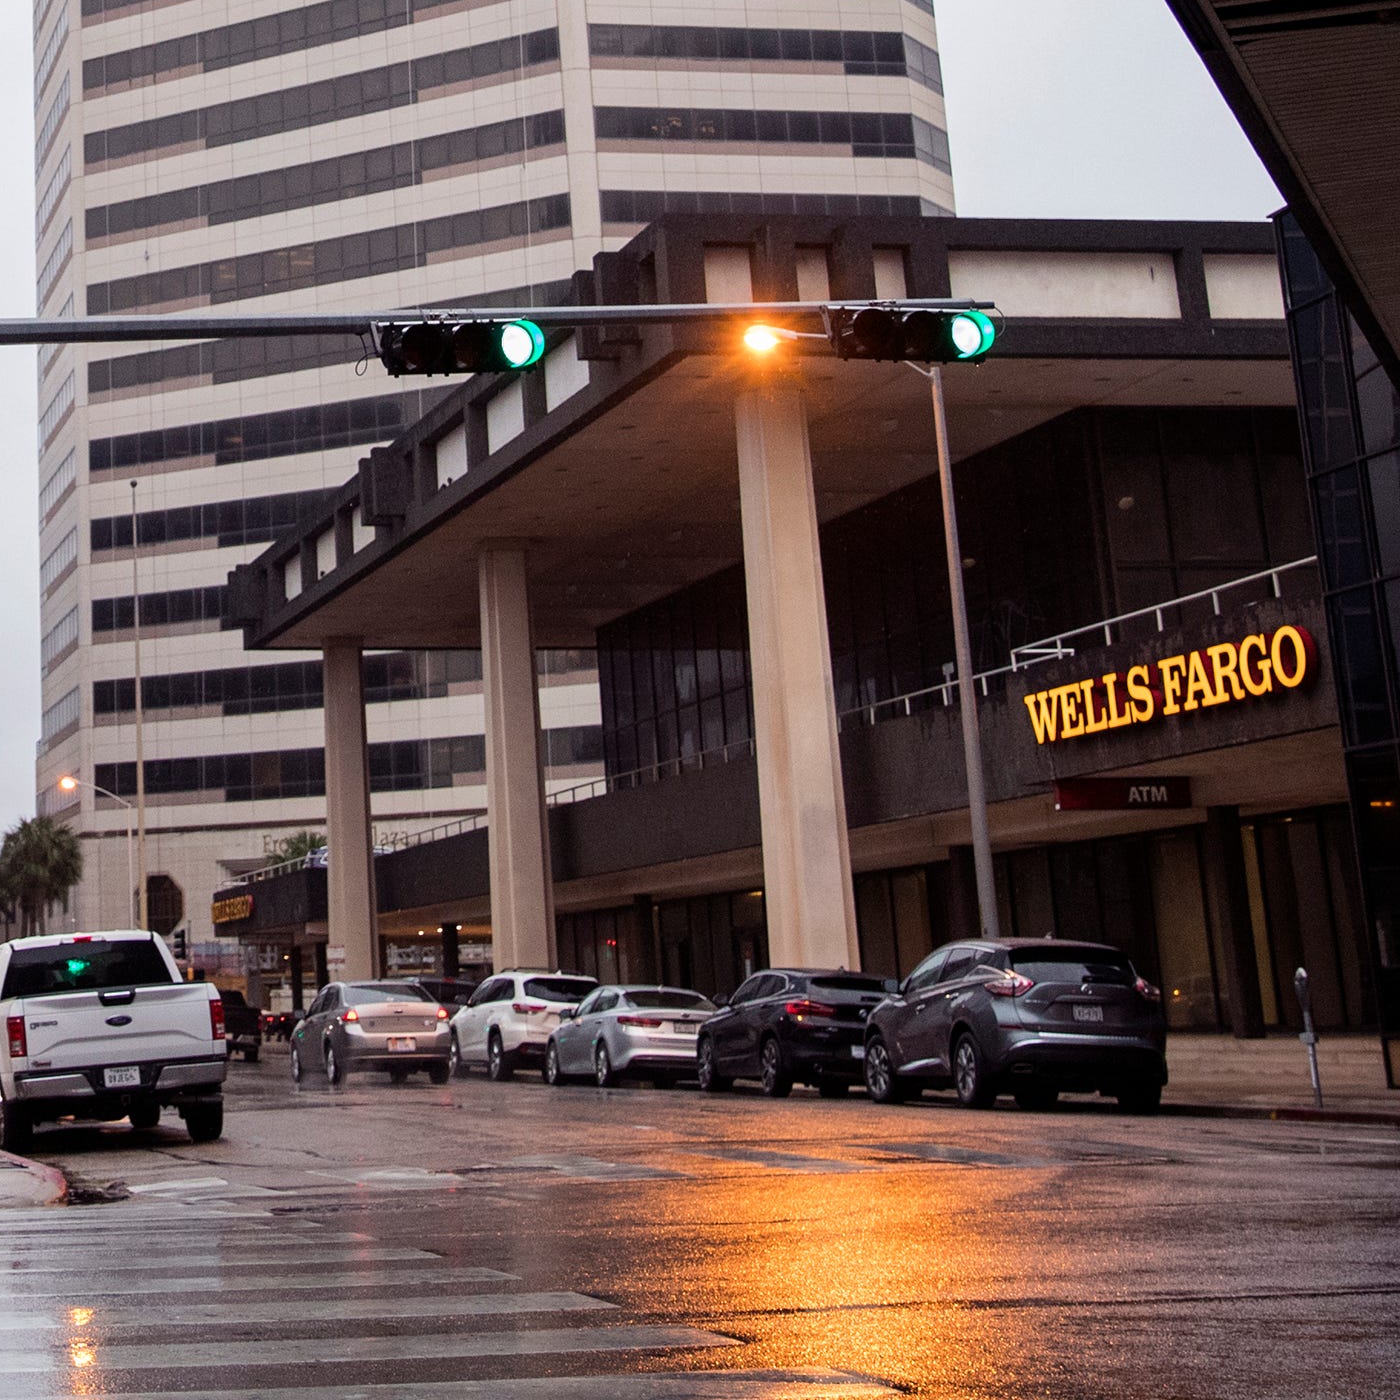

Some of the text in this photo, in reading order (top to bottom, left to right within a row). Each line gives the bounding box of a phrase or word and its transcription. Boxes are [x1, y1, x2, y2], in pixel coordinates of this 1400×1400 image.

[1023, 625, 1308, 745] WELLS FARGO
[1127, 785, 1169, 803] ATM
